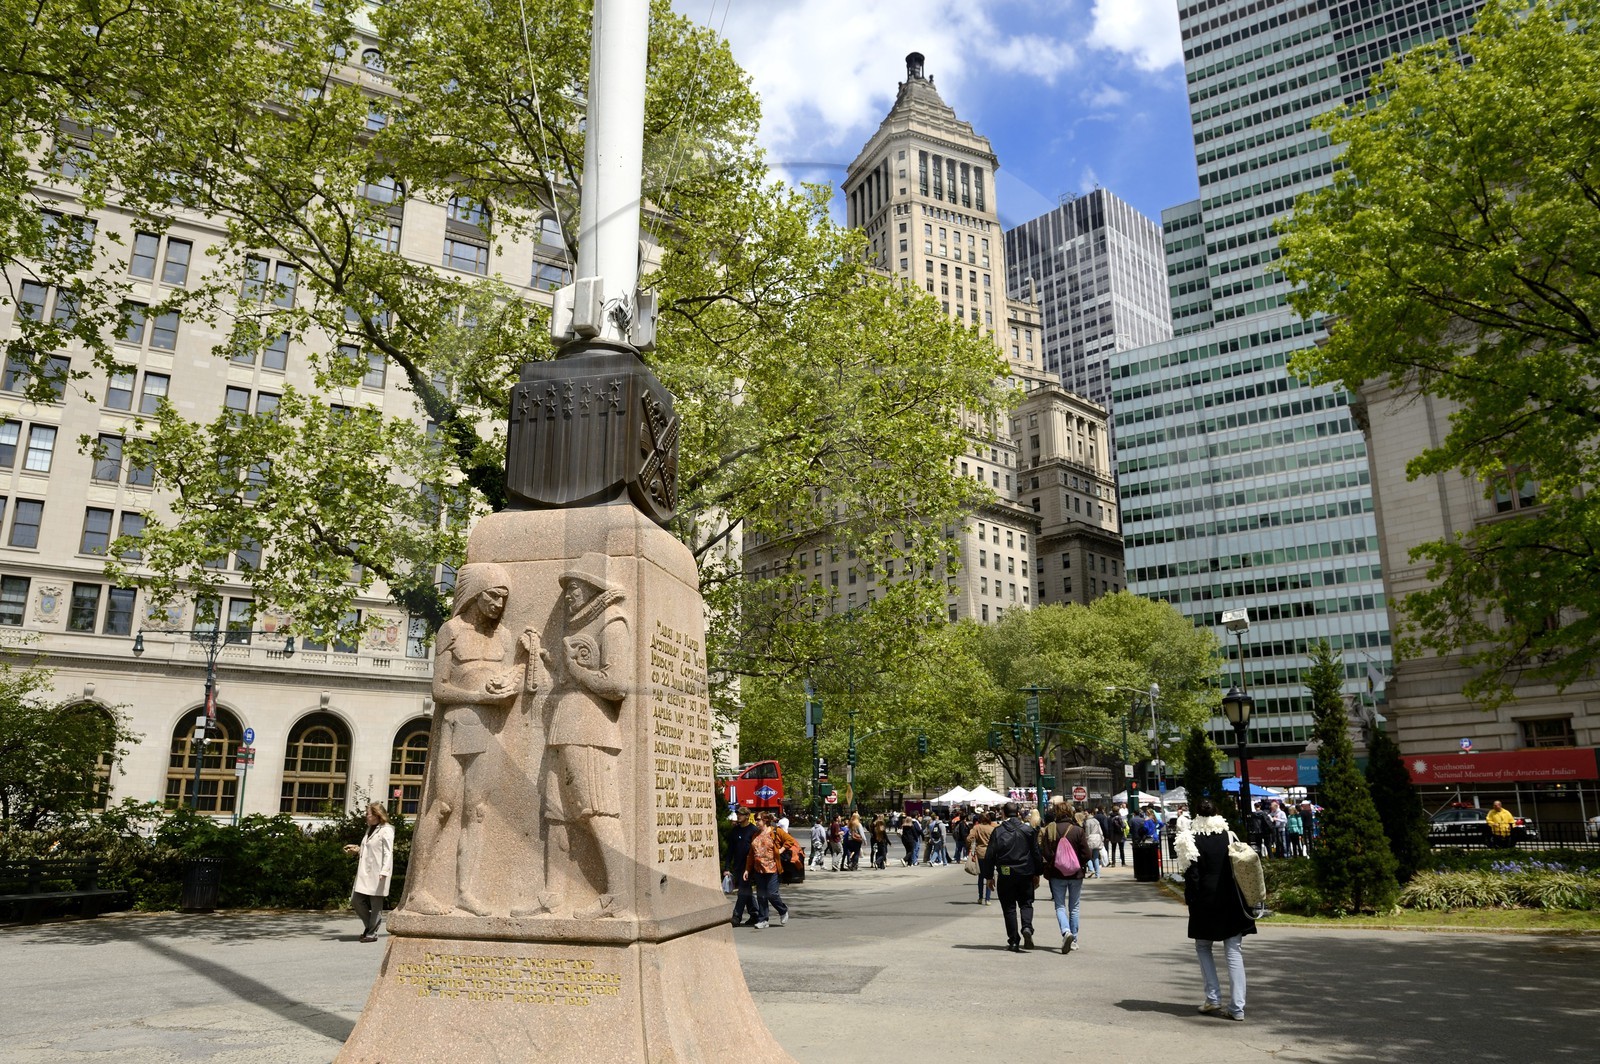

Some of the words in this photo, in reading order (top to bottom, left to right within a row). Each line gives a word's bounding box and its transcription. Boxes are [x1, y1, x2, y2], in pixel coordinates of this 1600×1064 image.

[1432, 763, 1476, 771] Smithsonian
[1434, 771, 1463, 779] National
[1464, 770, 1494, 778] Museum
[1495, 769, 1503, 779] of
[1503, 769, 1515, 777] the
[1515, 768, 1550, 777] American
[1551, 768, 1577, 776] Indian
[439, 954, 499, 966] TESTIMONY
[503, 956, 517, 967] OF
[522, 958, 567, 969] ANCIENT
[572, 960, 595, 970] AND
[530, 971, 555, 981] THIS
[513, 981, 539, 992] CITY
